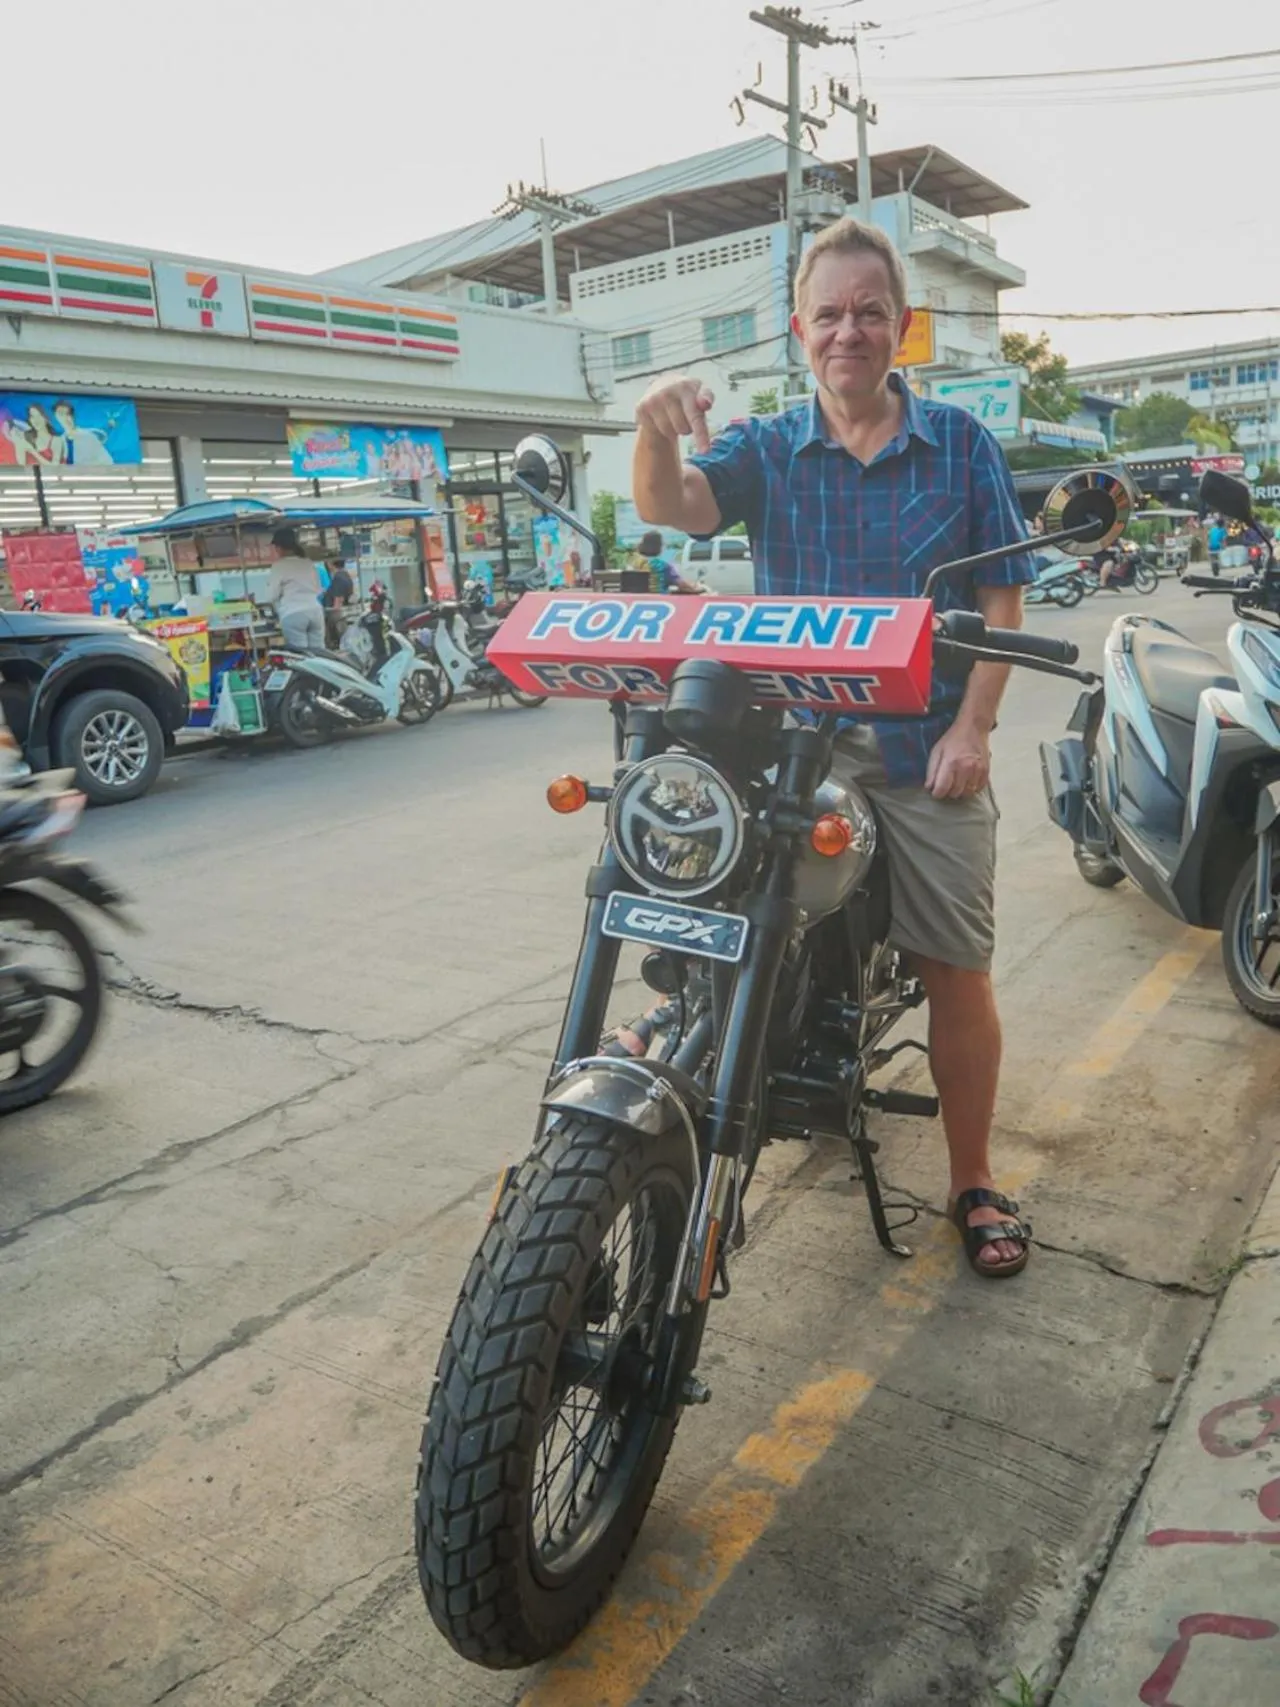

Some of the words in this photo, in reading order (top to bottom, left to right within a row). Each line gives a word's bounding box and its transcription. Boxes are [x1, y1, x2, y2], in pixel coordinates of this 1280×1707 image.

[184, 271, 218, 328] 7
[528, 600, 675, 642] FOR
[685, 602, 899, 650] RENT
[523, 661, 668, 696] FOR
[738, 670, 881, 706] ENT
[624, 907, 724, 946] GPX
